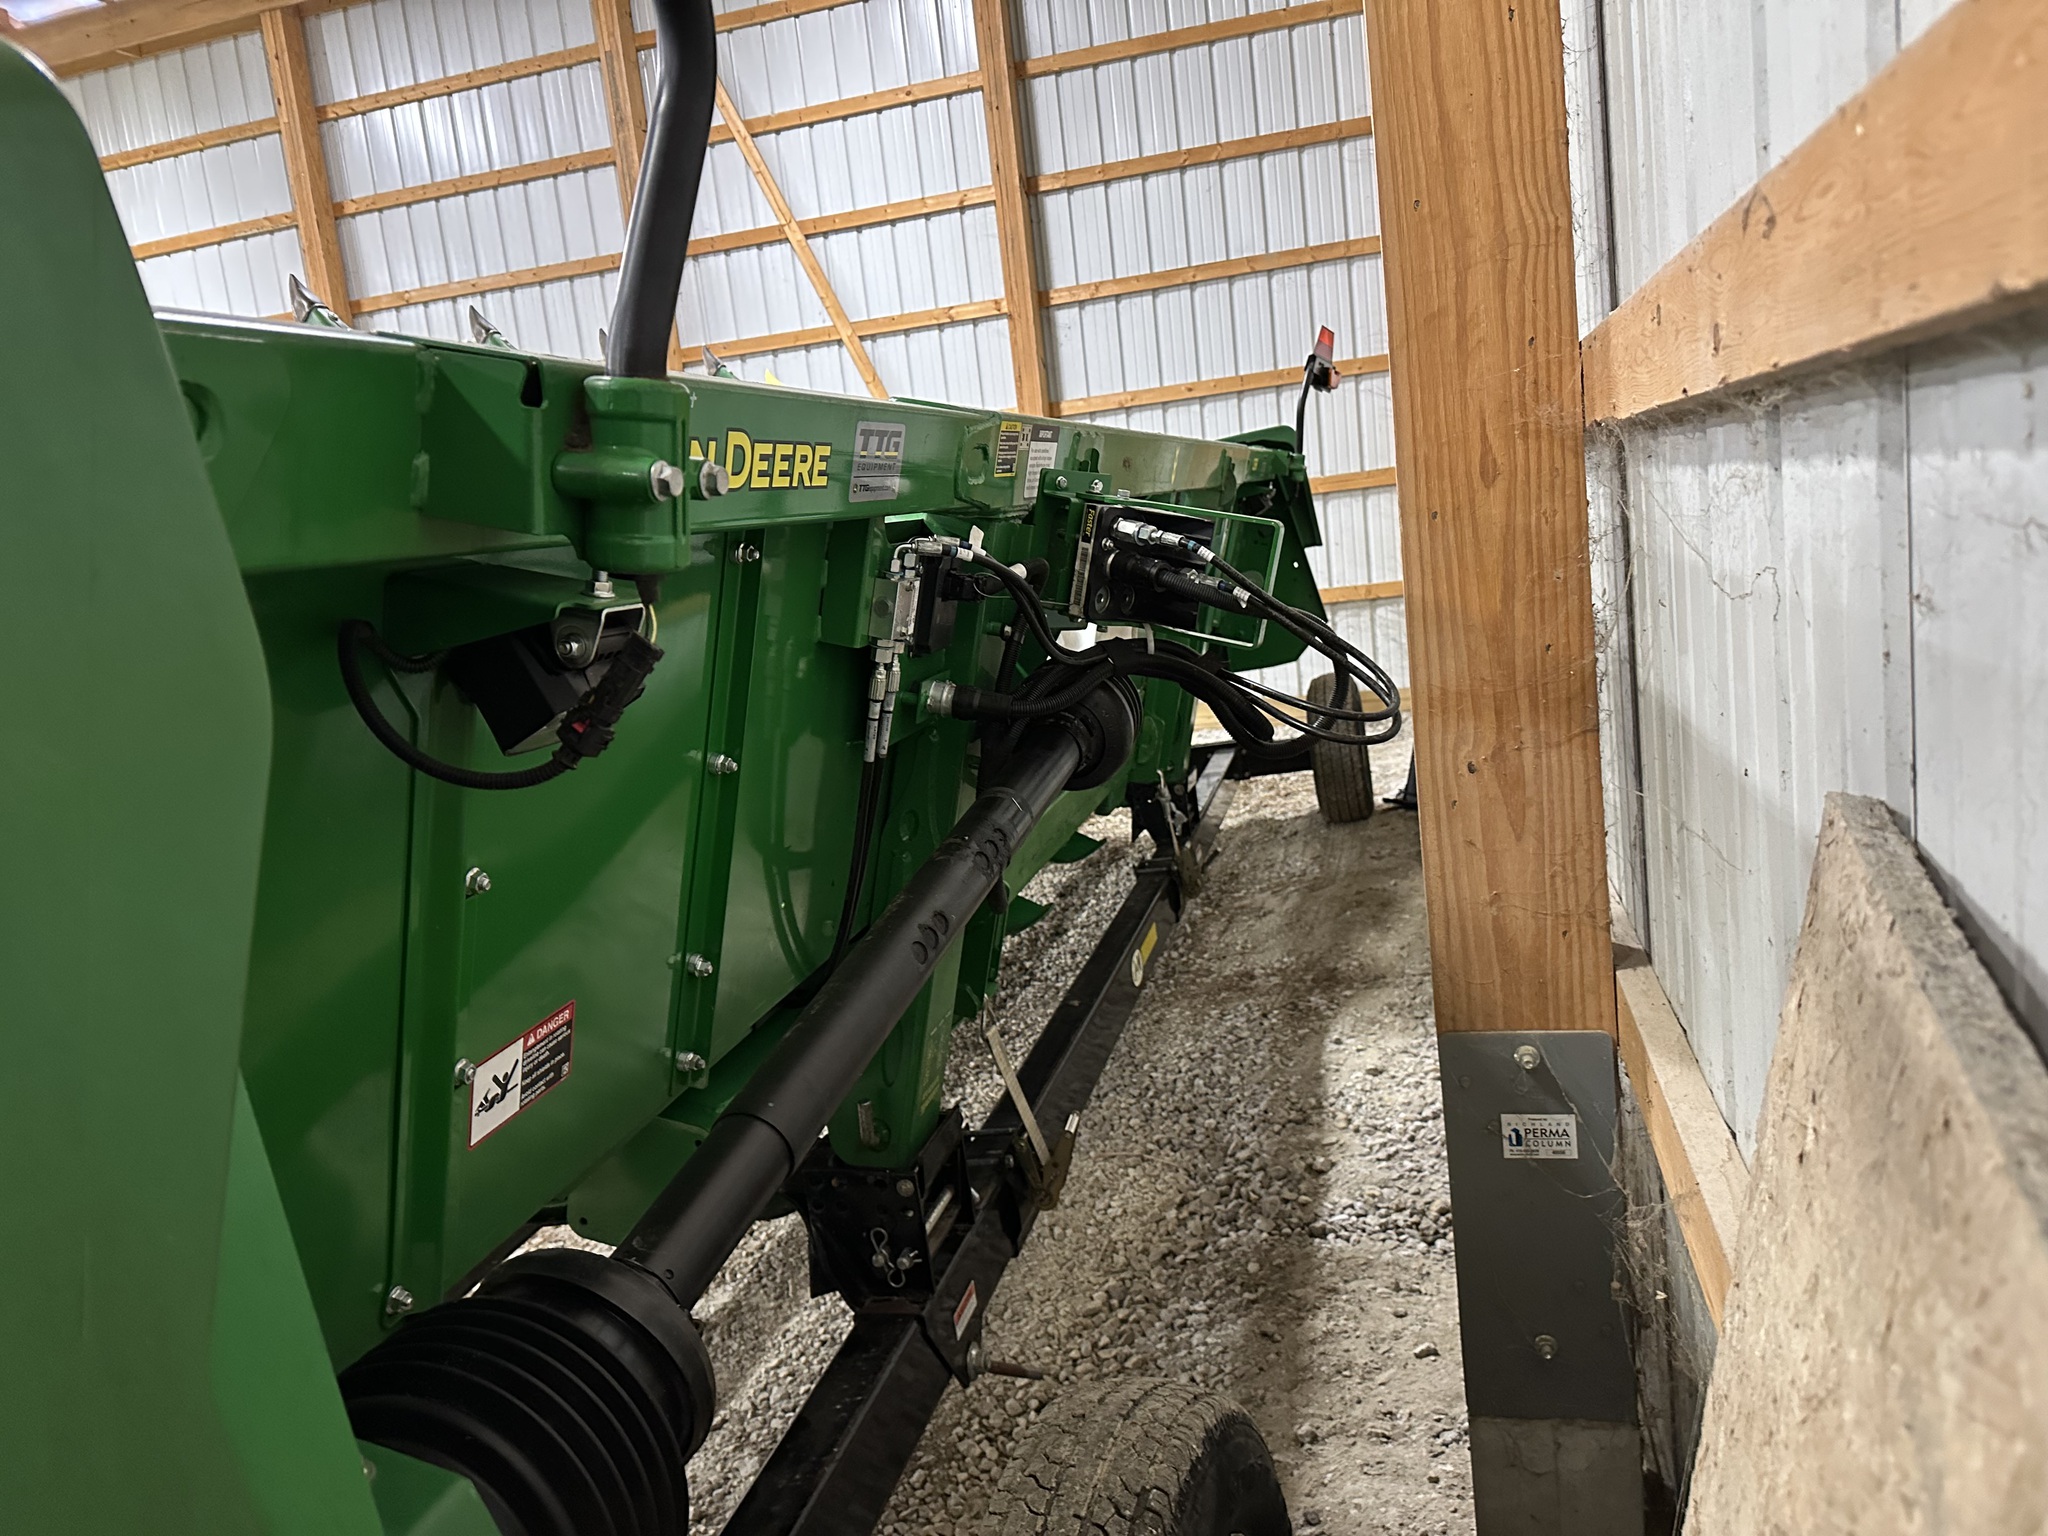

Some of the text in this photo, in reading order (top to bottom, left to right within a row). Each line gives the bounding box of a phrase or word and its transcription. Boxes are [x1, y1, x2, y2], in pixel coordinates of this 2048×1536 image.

[859, 429, 903, 459] TTG
[725, 428, 832, 491] DEERE
[857, 462, 897, 472] EQUIPMENT
[1085, 508, 1096, 538] Faster
[536, 1010, 570, 1040] DANGER
[1524, 1128, 1570, 1138] PERMA
